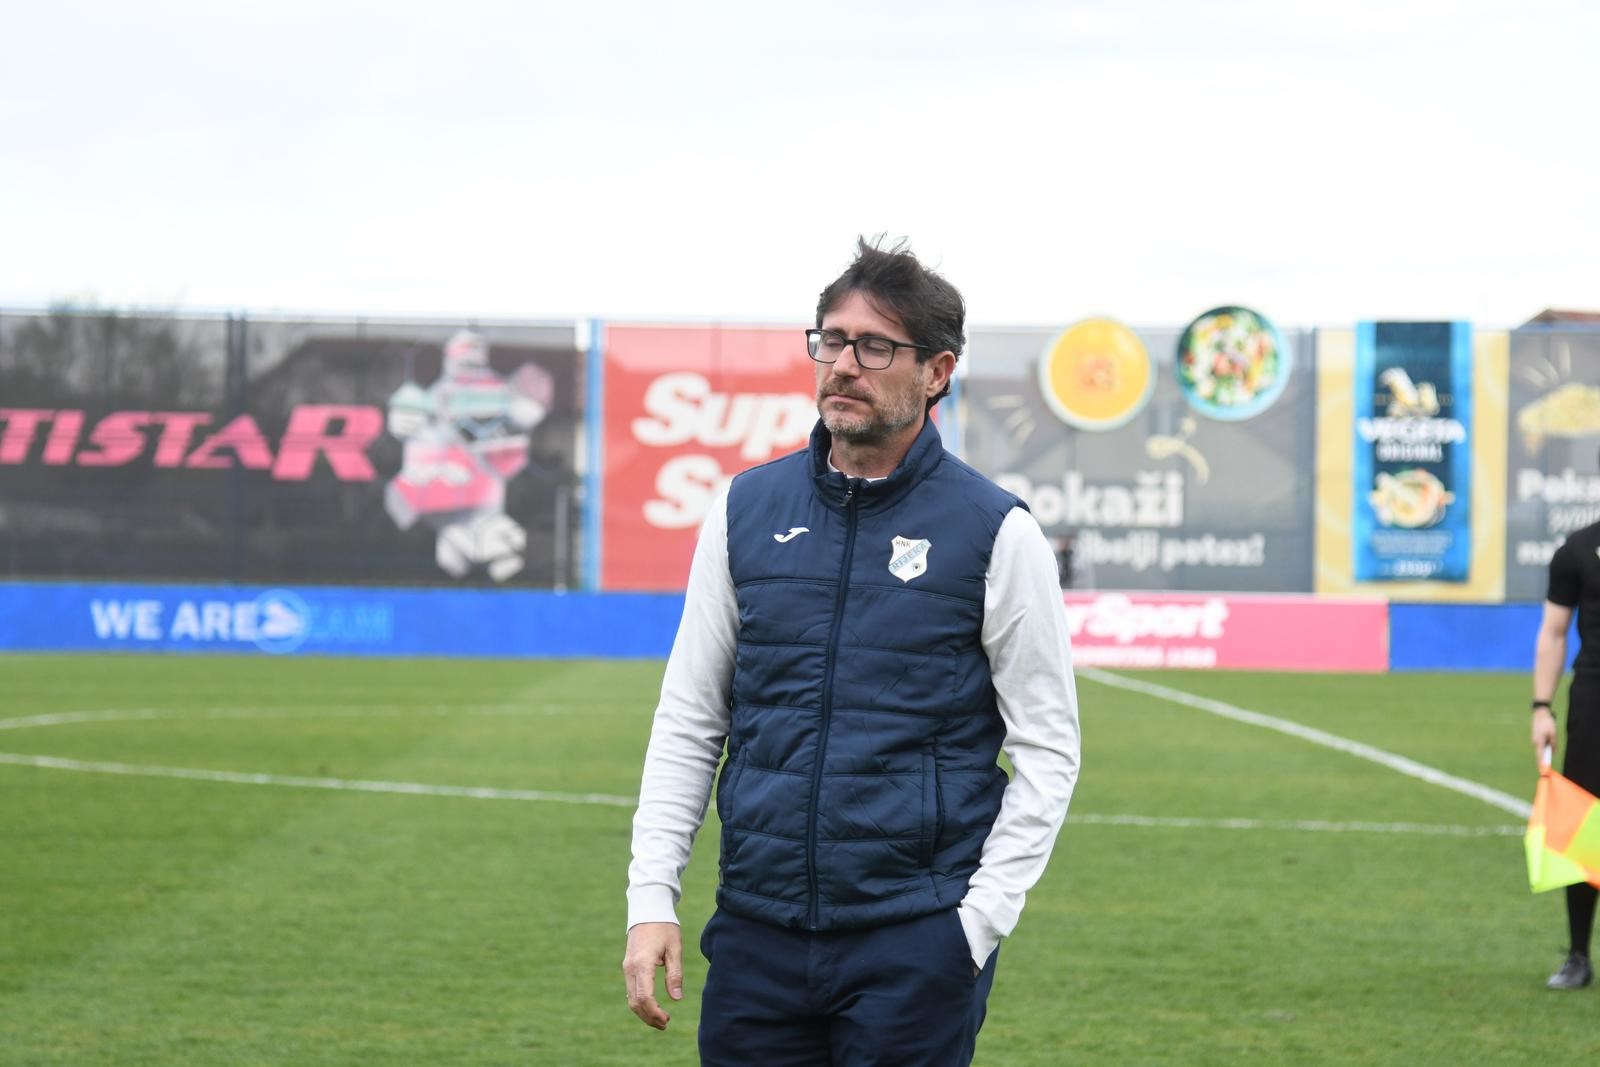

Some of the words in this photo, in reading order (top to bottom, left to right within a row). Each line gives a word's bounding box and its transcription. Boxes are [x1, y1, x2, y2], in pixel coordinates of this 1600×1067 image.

[894, 539, 911, 549] HNK
[90, 600, 163, 639] WE
[170, 601, 256, 640] ARE
